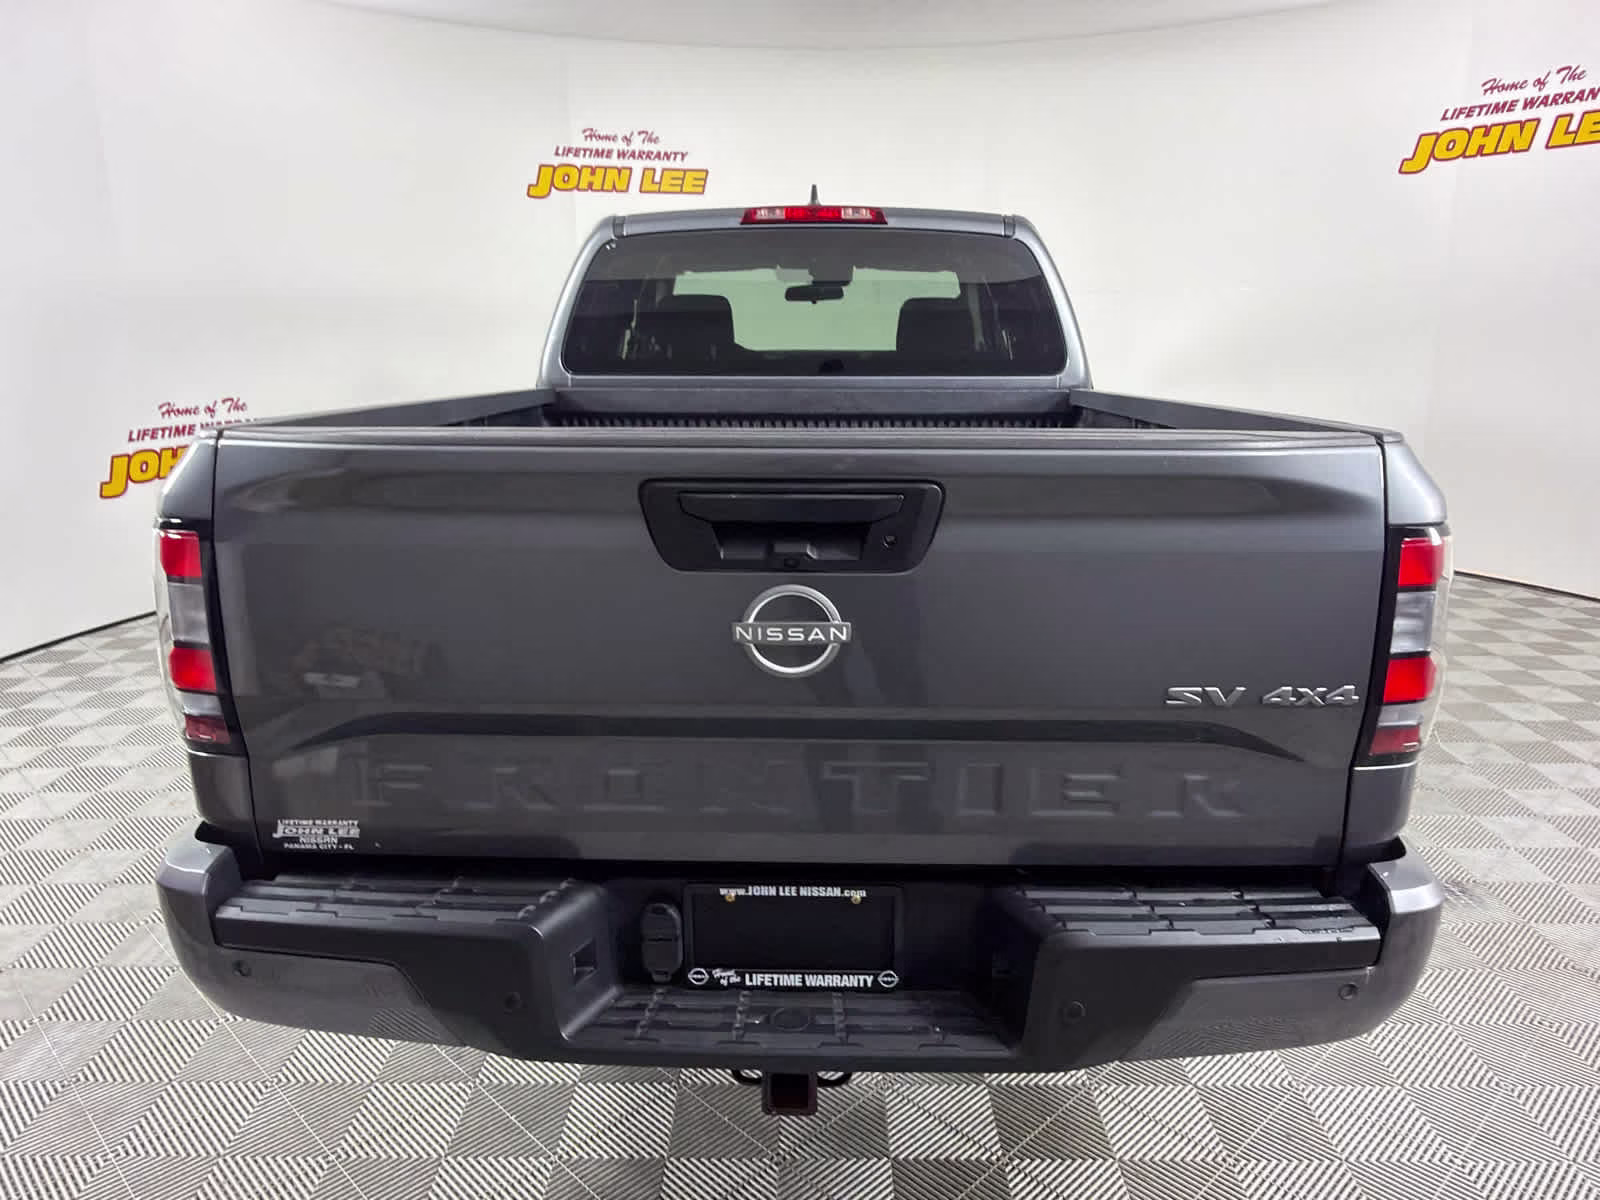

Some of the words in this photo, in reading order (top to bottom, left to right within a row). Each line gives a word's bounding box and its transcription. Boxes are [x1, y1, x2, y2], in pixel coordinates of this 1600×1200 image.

[1481, 78, 1529, 96] Home
[1532, 70, 1552, 92] of
[1555, 64, 1586, 84] The
[1440, 98, 1520, 122] LIFETIME
[1522, 86, 1600, 111] WARRAN
[582, 127, 618, 142] Home
[621, 131, 634, 146] of
[637, 130, 660, 145] The
[1399, 117, 1541, 174] JOHN
[1545, 109, 1600, 149] LE
[554, 145, 613, 160] LIFETIME
[616, 149, 688, 162] WARRANTY
[527, 163, 632, 198] JOHN
[640, 167, 708, 194] LEE
[158, 402, 199, 419] Home
[203, 400, 217, 418] of
[221, 396, 248, 413] The
[127, 423, 196, 443] LIFETIME
[735, 625, 848, 642] NISSAN
[1166, 686, 1246, 705] SV
[350, 757, 1247, 820] FRONTIER
[719, 885, 777, 897] www.JOHN
[778, 885, 798, 897] LEE
[799, 886, 867, 898] NISSAN.com
[744, 973, 803, 987] LIFETIME
[804, 974, 875, 988] WARRANTY
